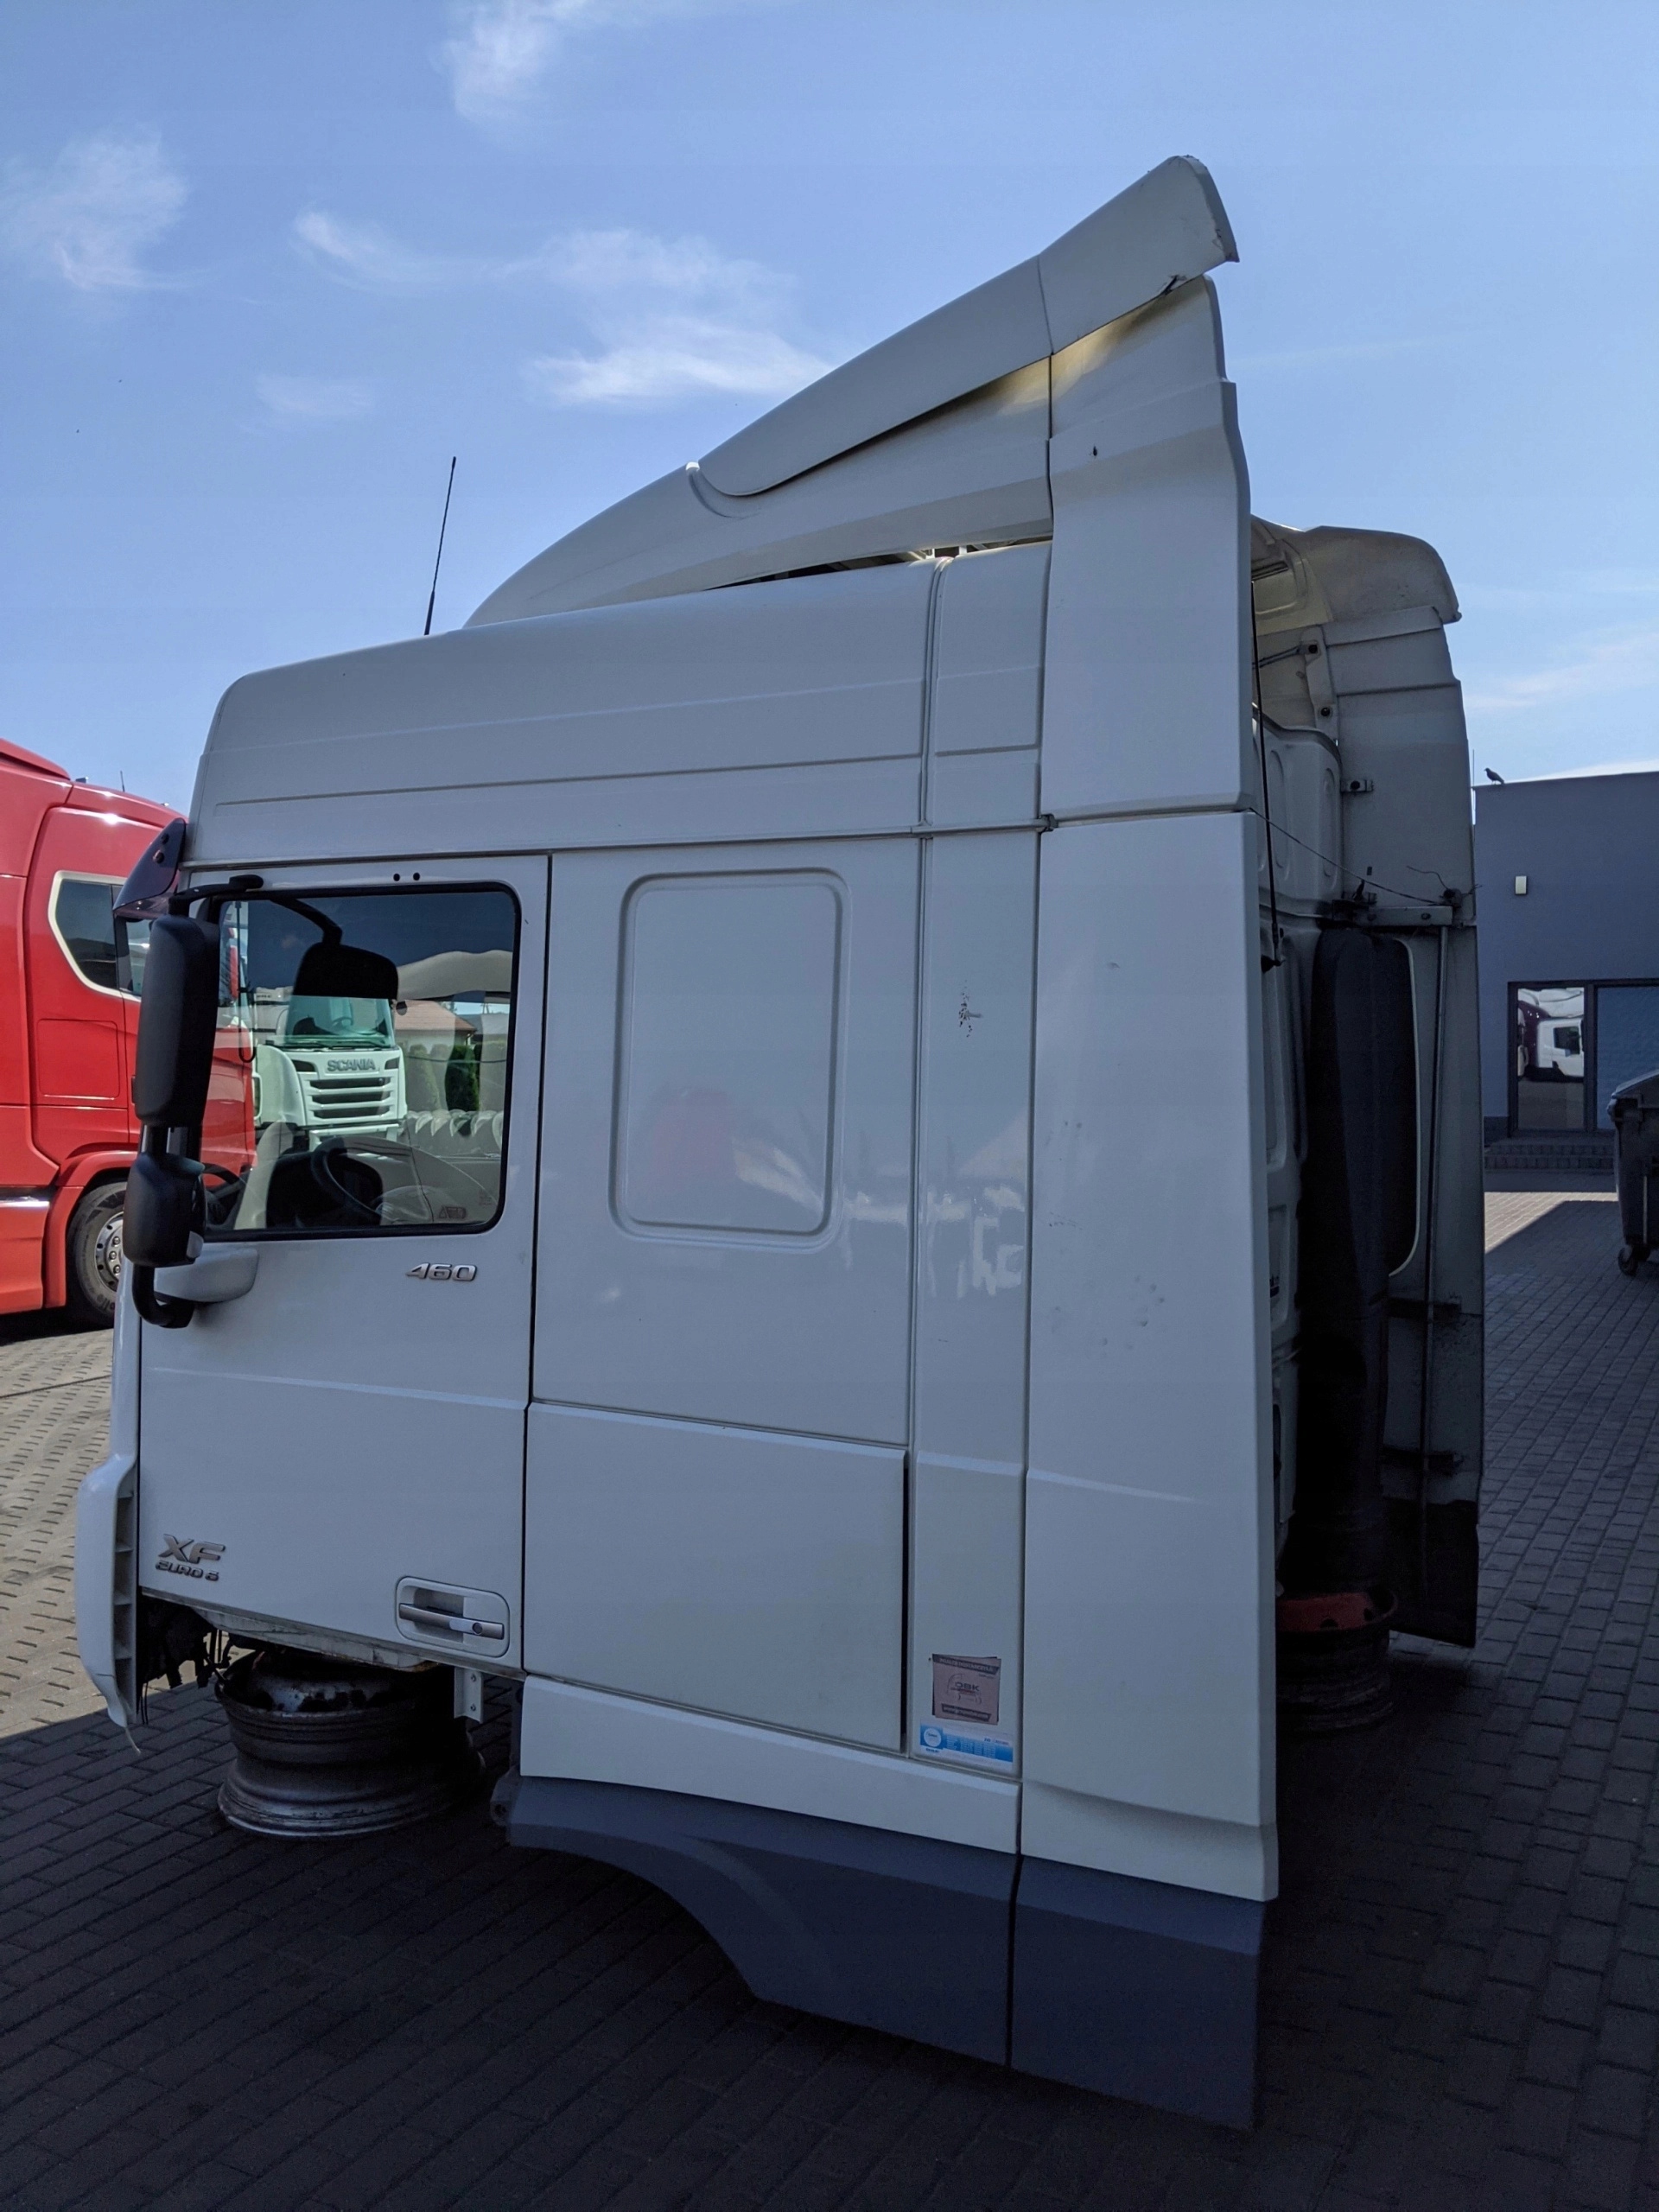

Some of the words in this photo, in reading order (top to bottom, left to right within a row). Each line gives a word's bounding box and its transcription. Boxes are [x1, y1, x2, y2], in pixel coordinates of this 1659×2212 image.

[327, 1058, 376, 1072] SCANIA
[406, 1262, 477, 1281] 460
[158, 1534, 226, 1564] XF
[156, 1560, 204, 1579] EURO
